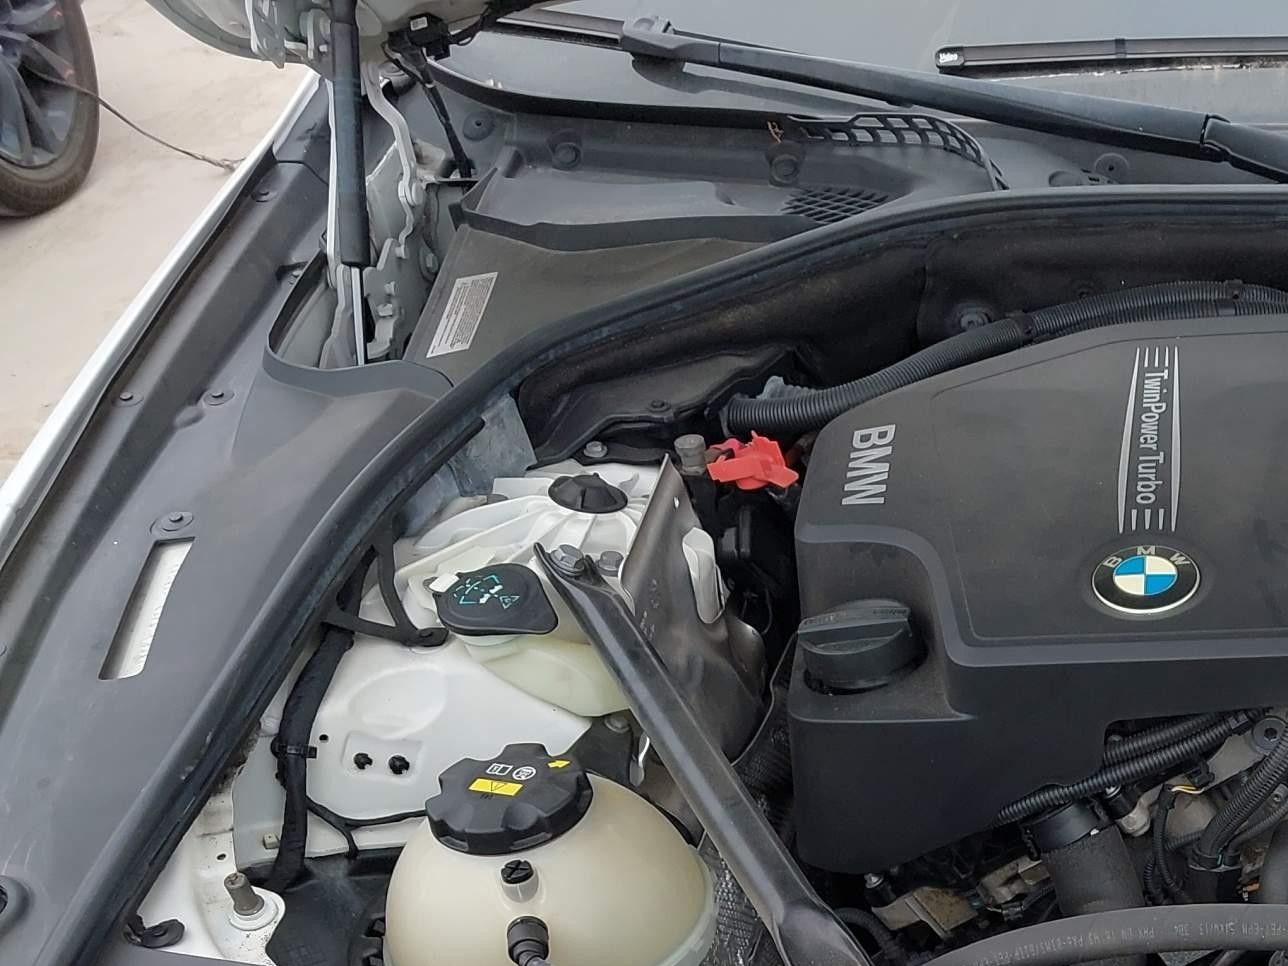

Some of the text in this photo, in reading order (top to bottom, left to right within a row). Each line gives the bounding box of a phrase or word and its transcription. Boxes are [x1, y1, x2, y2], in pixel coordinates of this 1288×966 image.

[842, 424, 896, 504] BMW
[1136, 368, 1168, 504] TwinPower Turbo
[1103, 546, 1190, 568] BMW
